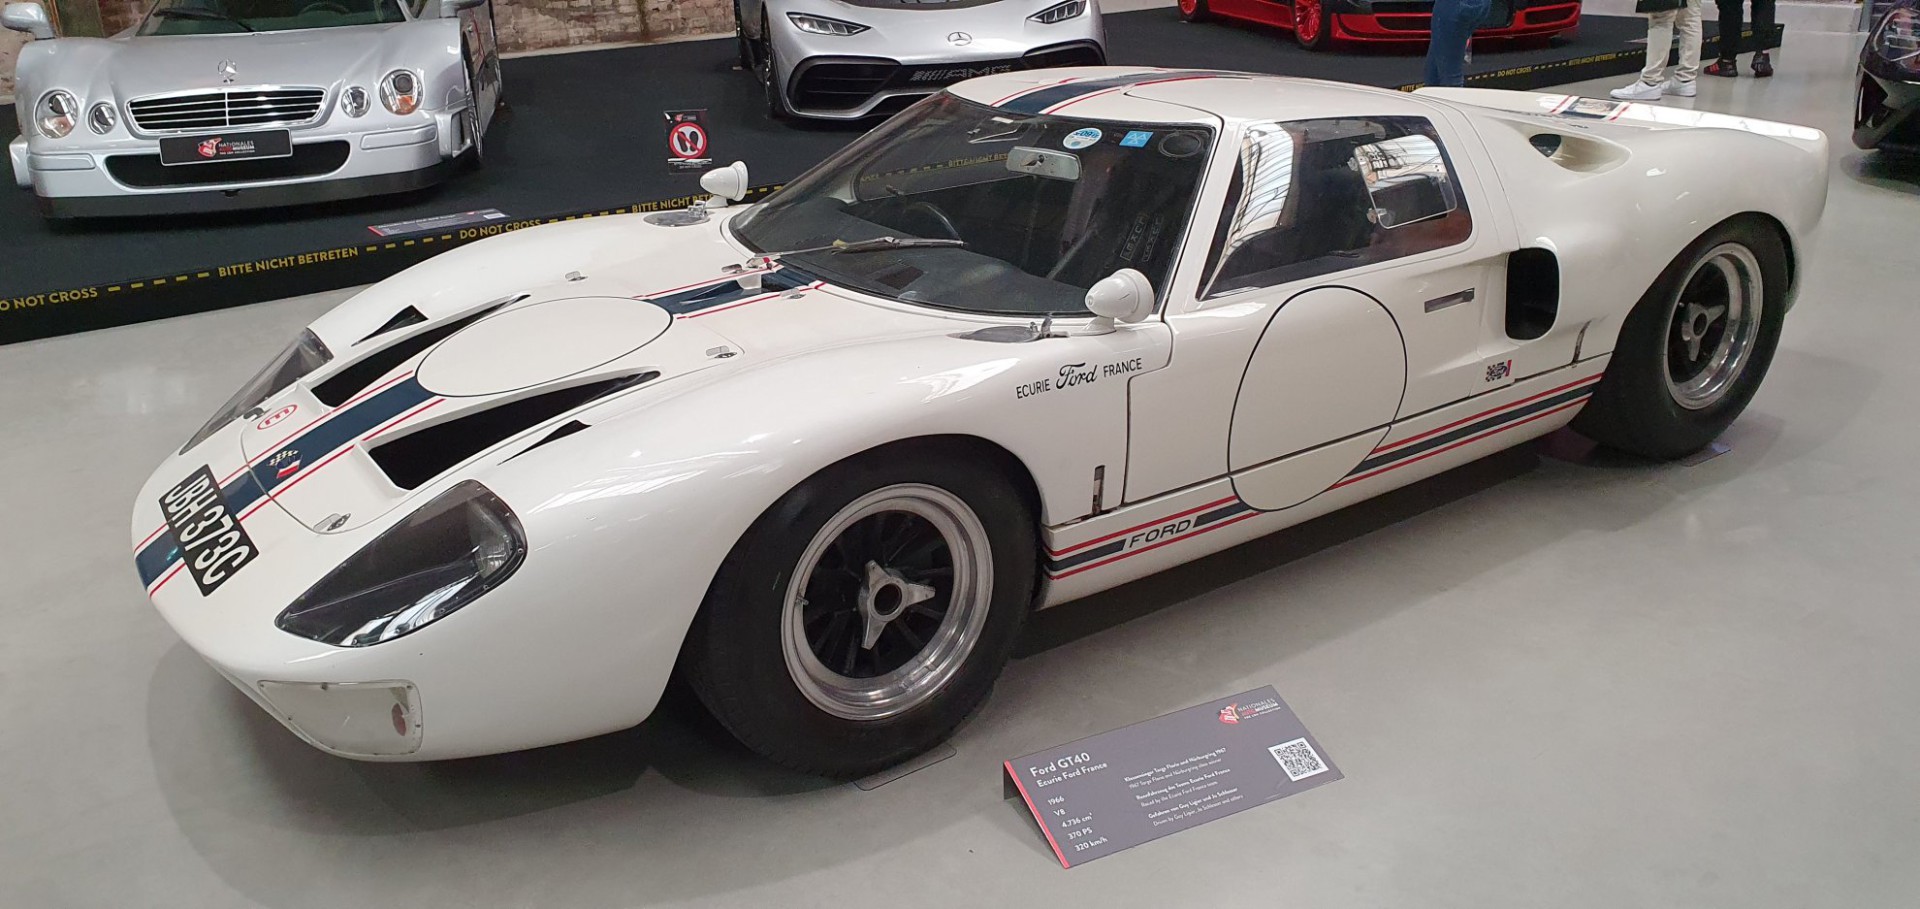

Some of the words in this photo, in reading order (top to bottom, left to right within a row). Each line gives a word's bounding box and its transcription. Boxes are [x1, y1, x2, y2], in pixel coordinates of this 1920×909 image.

[218, 140, 254, 148] NATIONALES
[632, 202, 658, 213] BITTE
[660, 196, 691, 209] NICHT
[460, 227, 477, 239] DO
[480, 225, 503, 236] NOT
[505, 220, 541, 232] CROSS
[219, 262, 253, 277] BITTE
[256, 256, 295, 271] NICHT
[297, 247, 359, 265] BETRETEN
[13, 294, 45, 309] NOT
[49, 287, 98, 303] CROSS
[1016, 379, 1051, 399] ECURIE
[1056, 362, 1097, 389] Ford
[1103, 358, 1142, 377] FRANCE
[1129, 519, 1191, 548] FORD
[1237, 698, 1275, 711] NATIONALES
[1215, 747, 1226, 755] 1967
[1029, 762, 1057, 777] Ford
[1057, 752, 1090, 768] GT40
[1036, 774, 1062, 788] Ecurie
[1062, 769, 1081, 780] Ford
[1081, 763, 1108, 774] France
[1203, 771, 1215, 779] Ford
[1047, 796, 1065, 806] 1966
[1053, 808, 1066, 817] V8
[1067, 830, 1082, 840] 370
[1082, 826, 1093, 835] PS
[1074, 842, 1089, 852] 320
[1089, 836, 1108, 847] km/h
